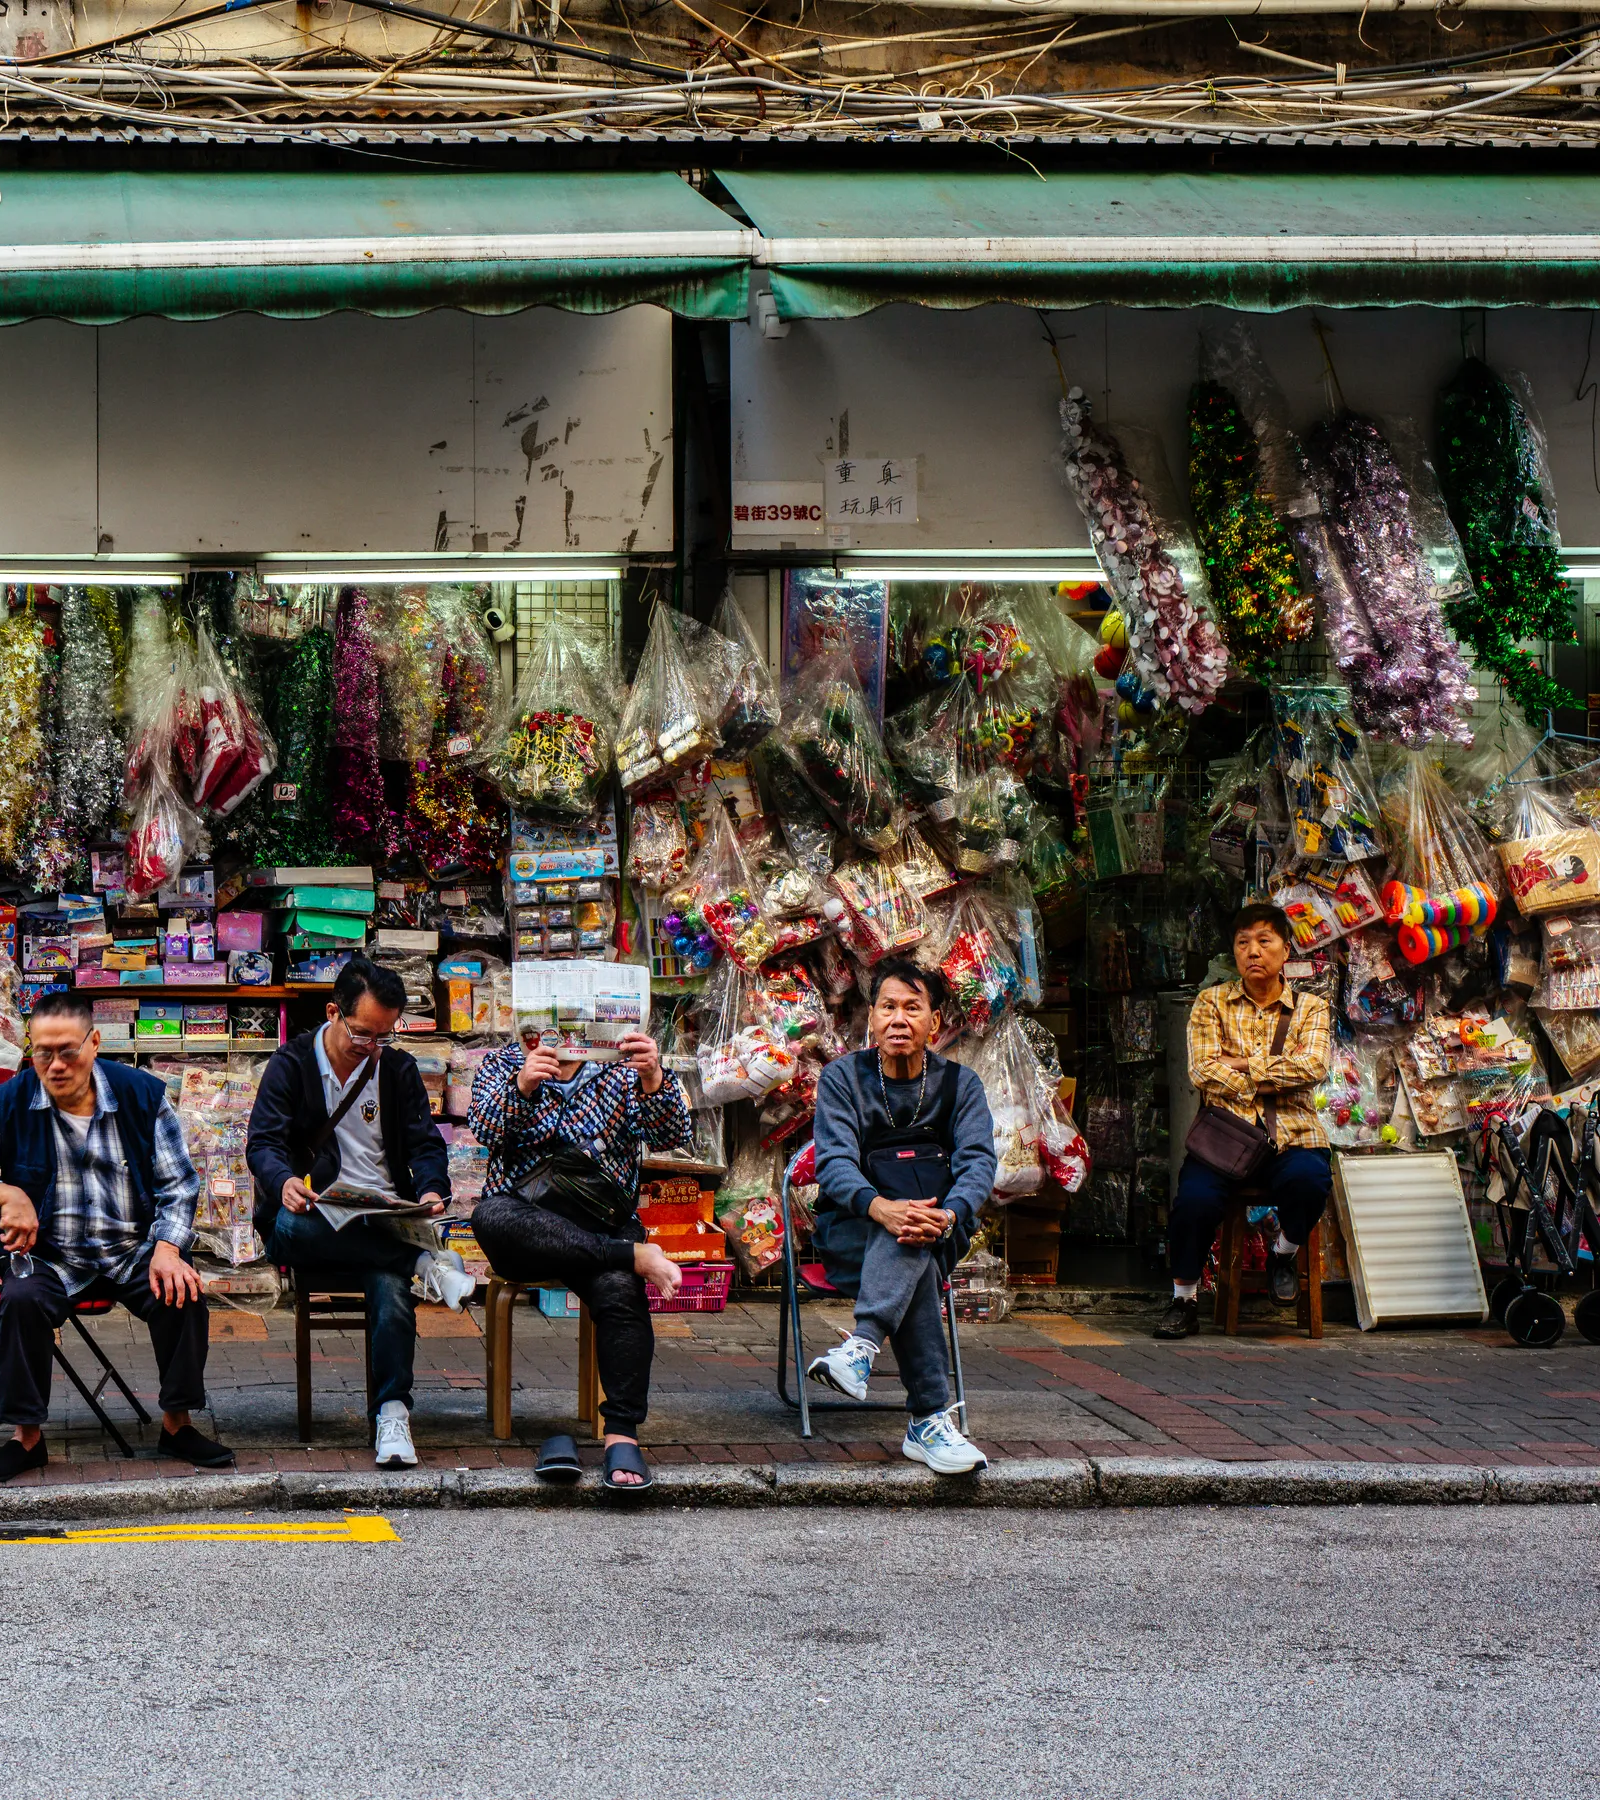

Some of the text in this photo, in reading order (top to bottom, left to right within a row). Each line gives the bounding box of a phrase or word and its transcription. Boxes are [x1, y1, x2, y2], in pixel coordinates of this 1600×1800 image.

[734, 504, 822, 521] 碧街39號C
[839, 496, 903, 516] 玩具行
[747, 1228, 762, 1240] 24
